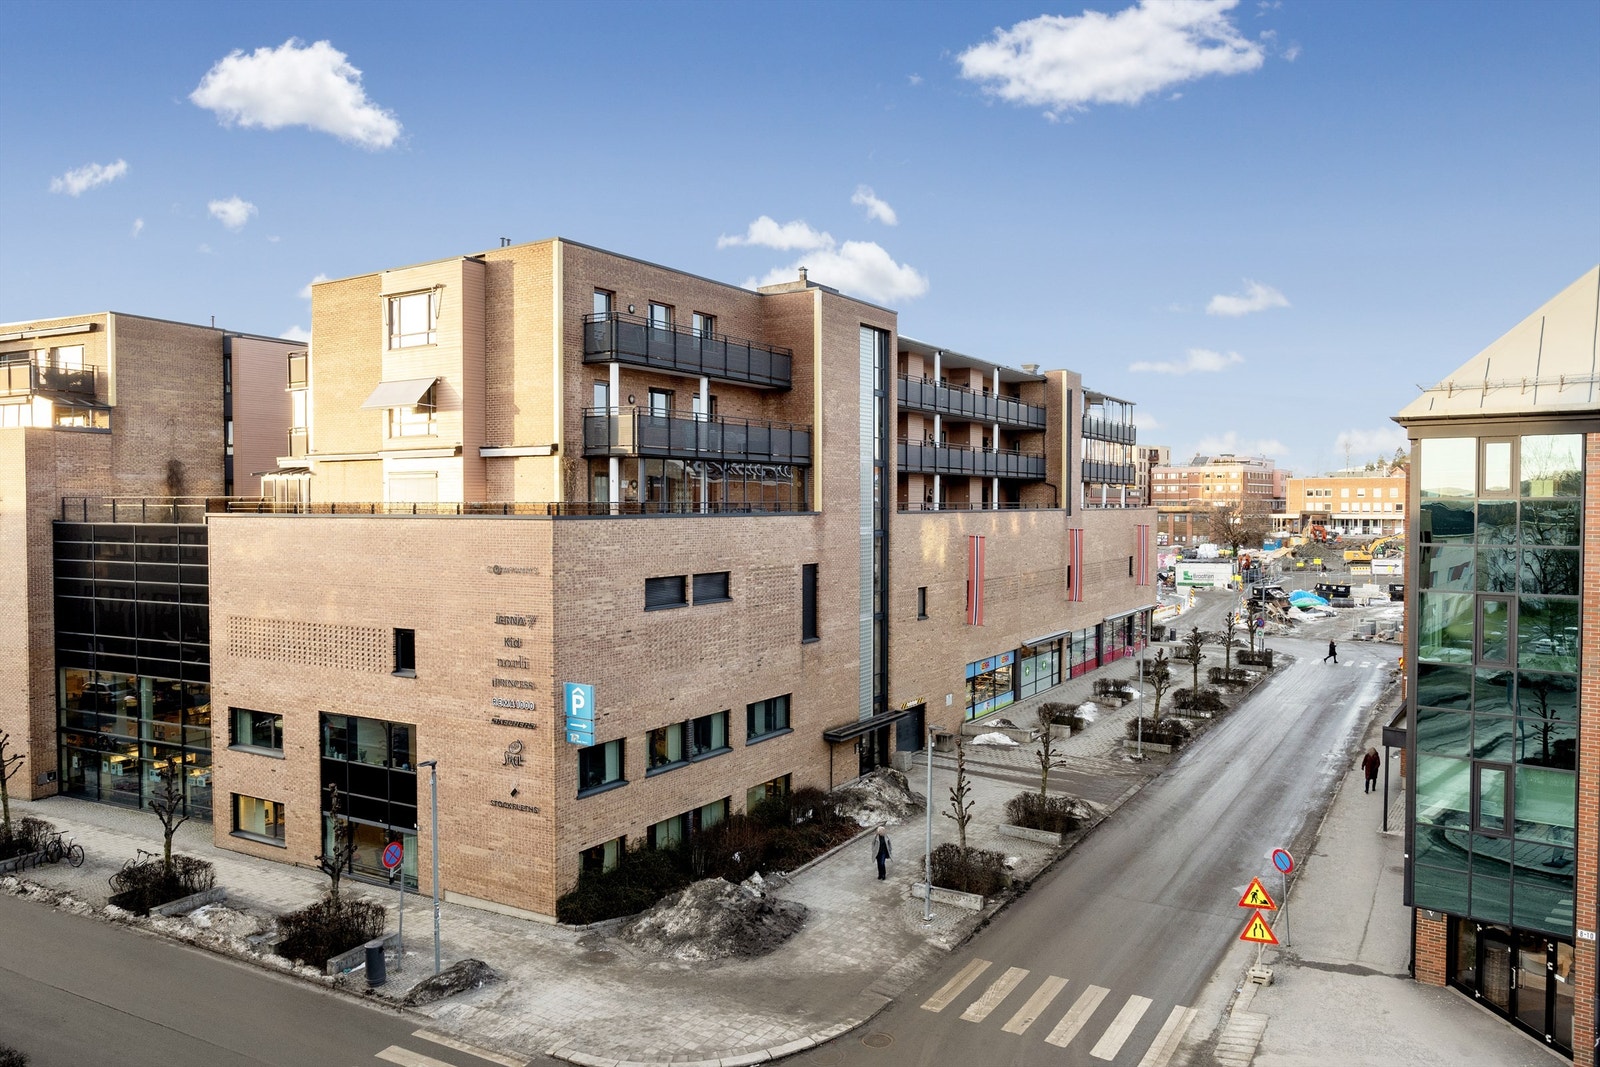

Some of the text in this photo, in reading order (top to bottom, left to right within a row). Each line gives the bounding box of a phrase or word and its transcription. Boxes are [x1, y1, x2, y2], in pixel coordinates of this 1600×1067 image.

[504, 637, 522, 648] Kid
[497, 656, 530, 669] norli
[492, 697, 535, 711] REMA 1000
